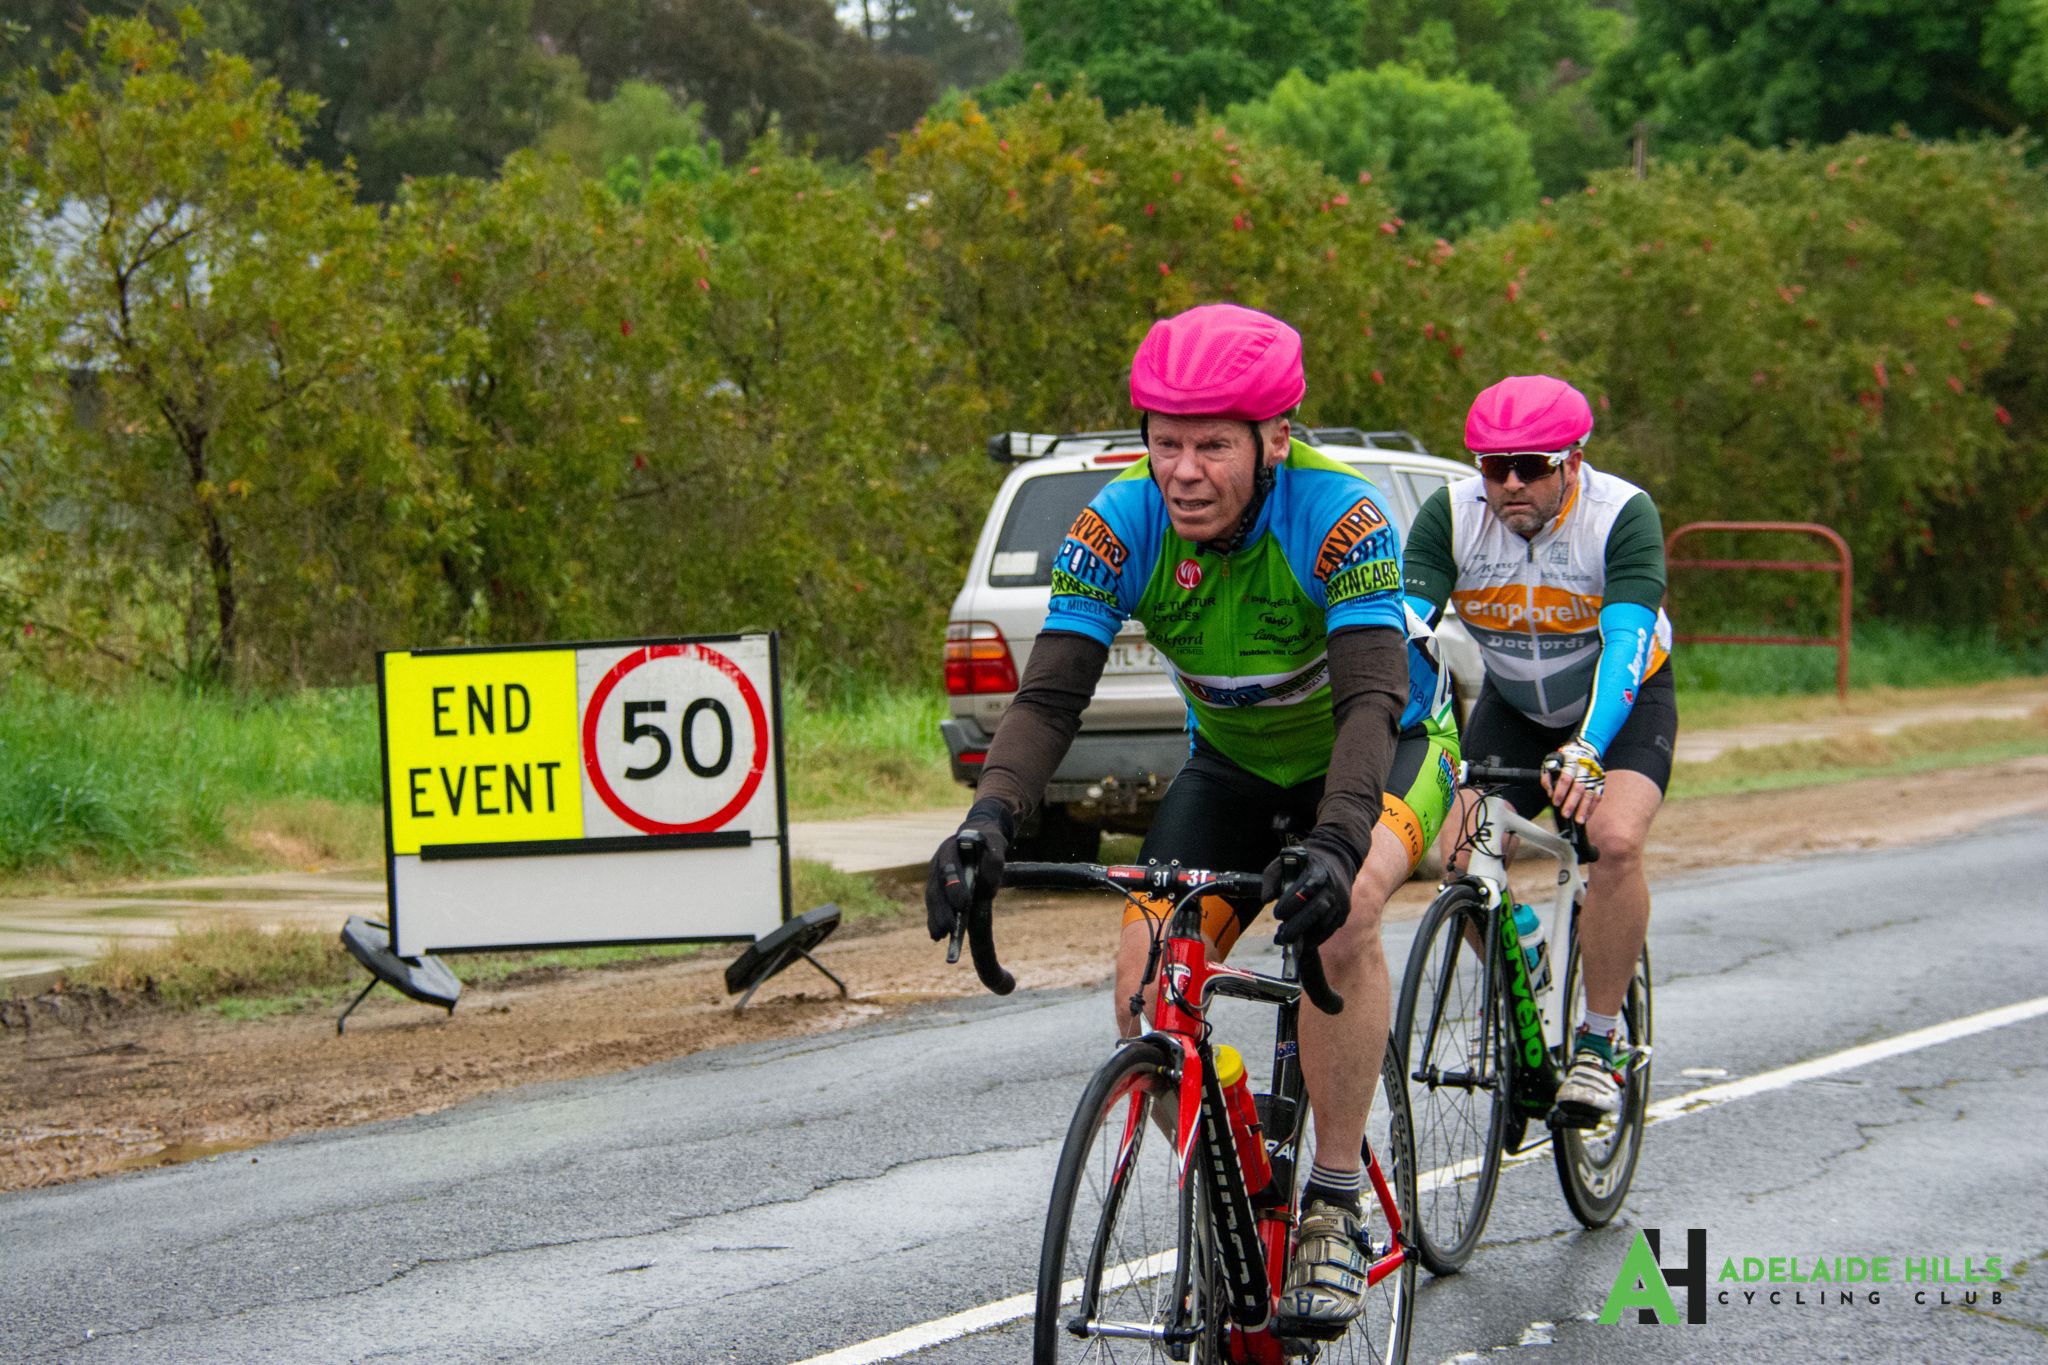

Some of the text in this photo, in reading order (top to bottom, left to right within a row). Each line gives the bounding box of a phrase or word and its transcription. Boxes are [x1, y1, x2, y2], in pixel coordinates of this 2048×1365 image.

[1316, 503, 1383, 579] ENVIRO
[1326, 561, 1398, 604] SKINCARE
[1153, 612, 1200, 623] CYCLES
[432, 683, 531, 738] END
[623, 697, 734, 781] 50
[408, 762, 562, 819] EVENT
[1154, 871, 1169, 888] 3T
[1186, 869, 1210, 887] 3T
